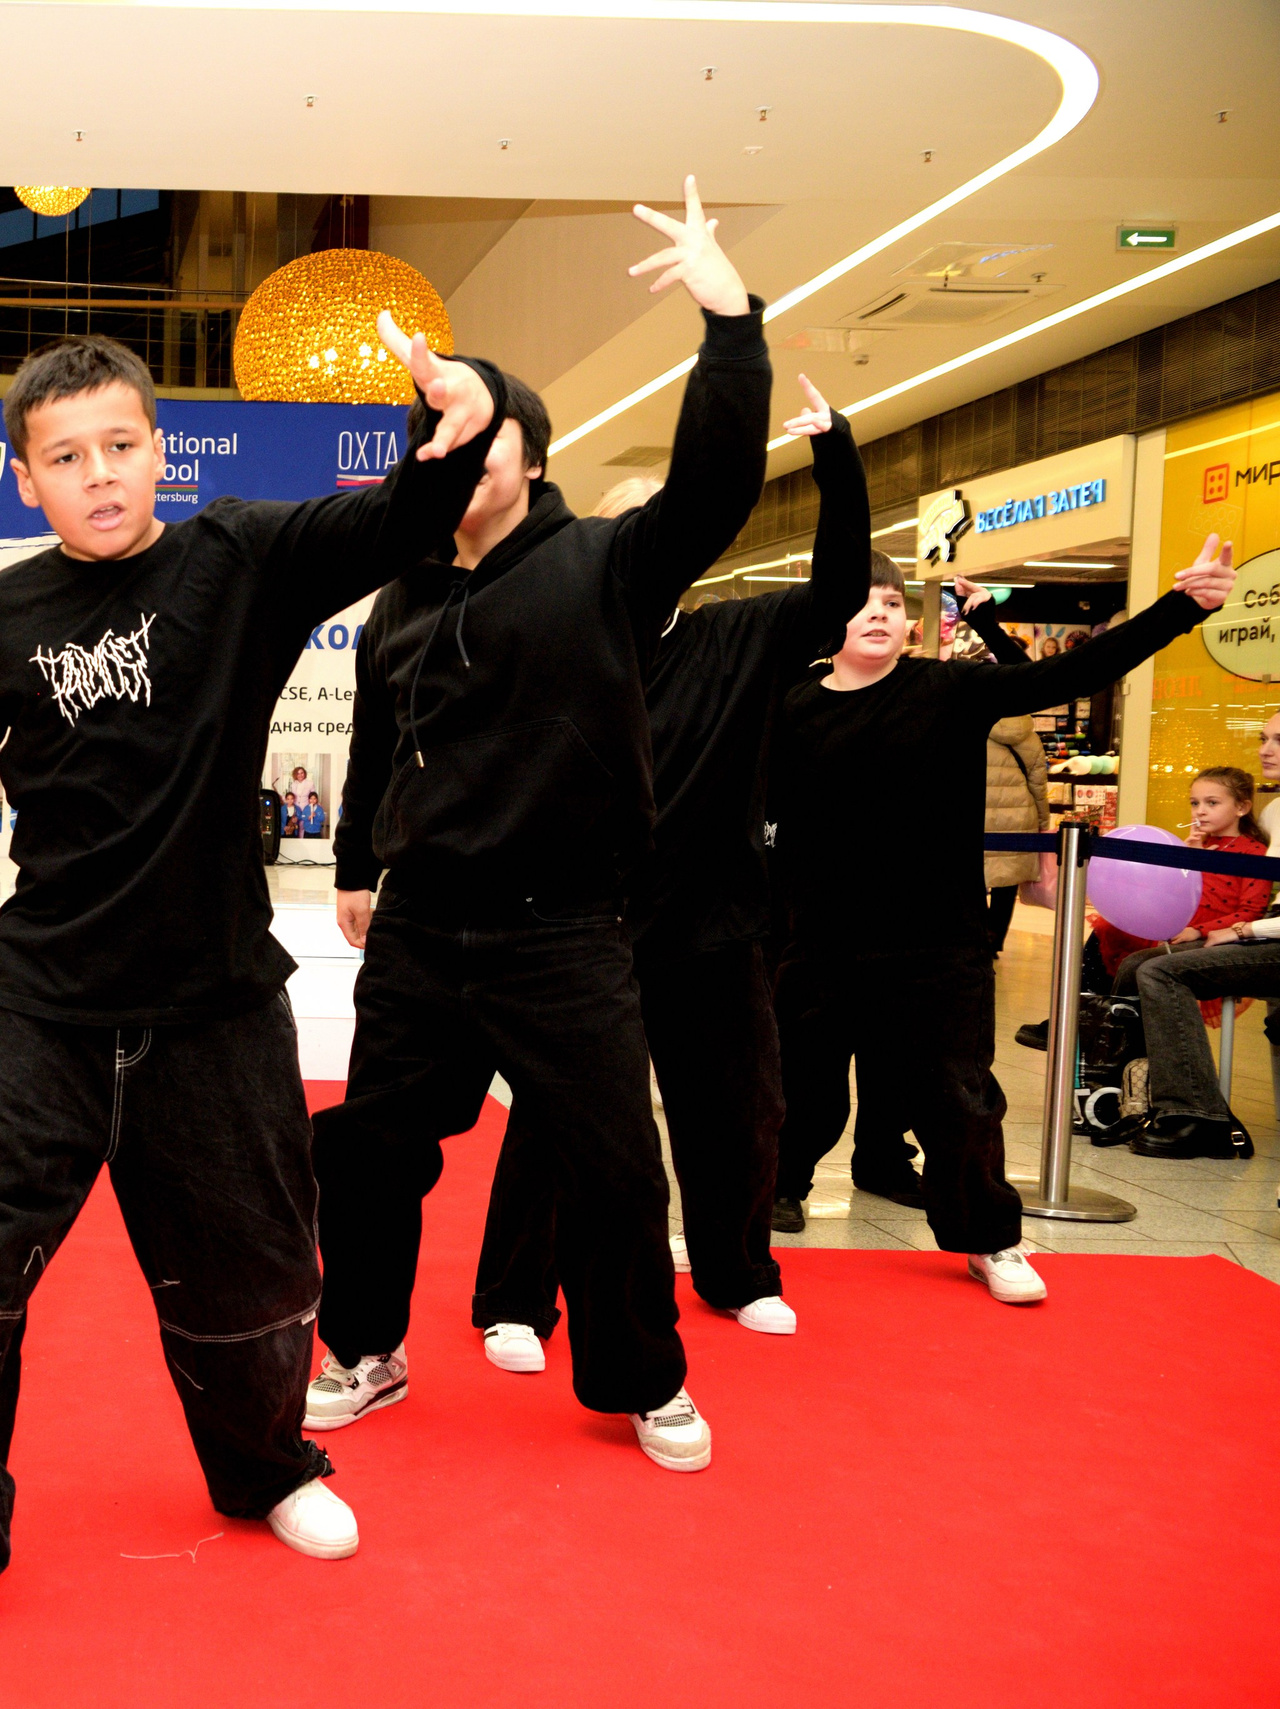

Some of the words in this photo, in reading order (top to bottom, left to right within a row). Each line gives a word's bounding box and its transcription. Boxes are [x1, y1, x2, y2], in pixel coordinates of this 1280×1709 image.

[975, 495, 1046, 533] ВЕСЁЛАЯ
[1047, 478, 1106, 515] ЗАТЕЯ
[1244, 584, 1280, 608] Соб
[1219, 615, 1276, 646] играй,
[270, 721, 312, 734] дная
